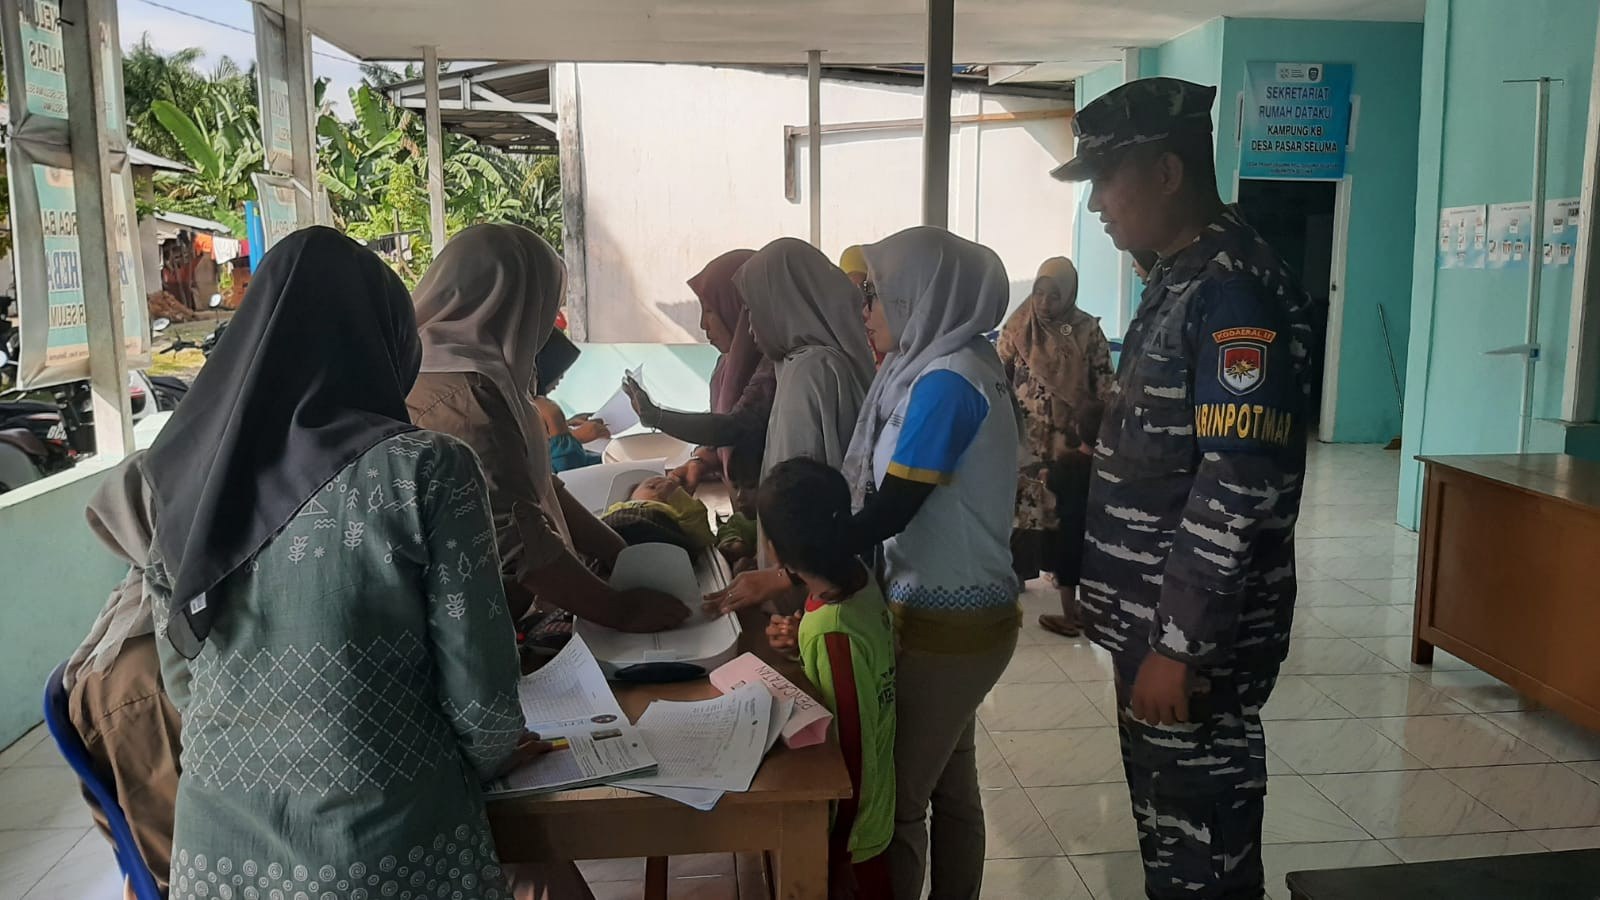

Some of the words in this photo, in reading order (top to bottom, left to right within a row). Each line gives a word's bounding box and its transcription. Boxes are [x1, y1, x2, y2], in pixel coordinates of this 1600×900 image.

[1266, 86, 1329, 99] SEKRETARIAT
[1259, 105, 1293, 118] RUMAH
[1295, 106, 1332, 118] DATAKU
[1267, 125, 1309, 136] KAMPUNG
[1311, 126, 1323, 136] KB
[1252, 140, 1273, 151] DESA
[1275, 141, 1302, 151] PASAR
[1304, 142, 1338, 152] SELUMA
[1217, 329, 1262, 340] KODAERAL
